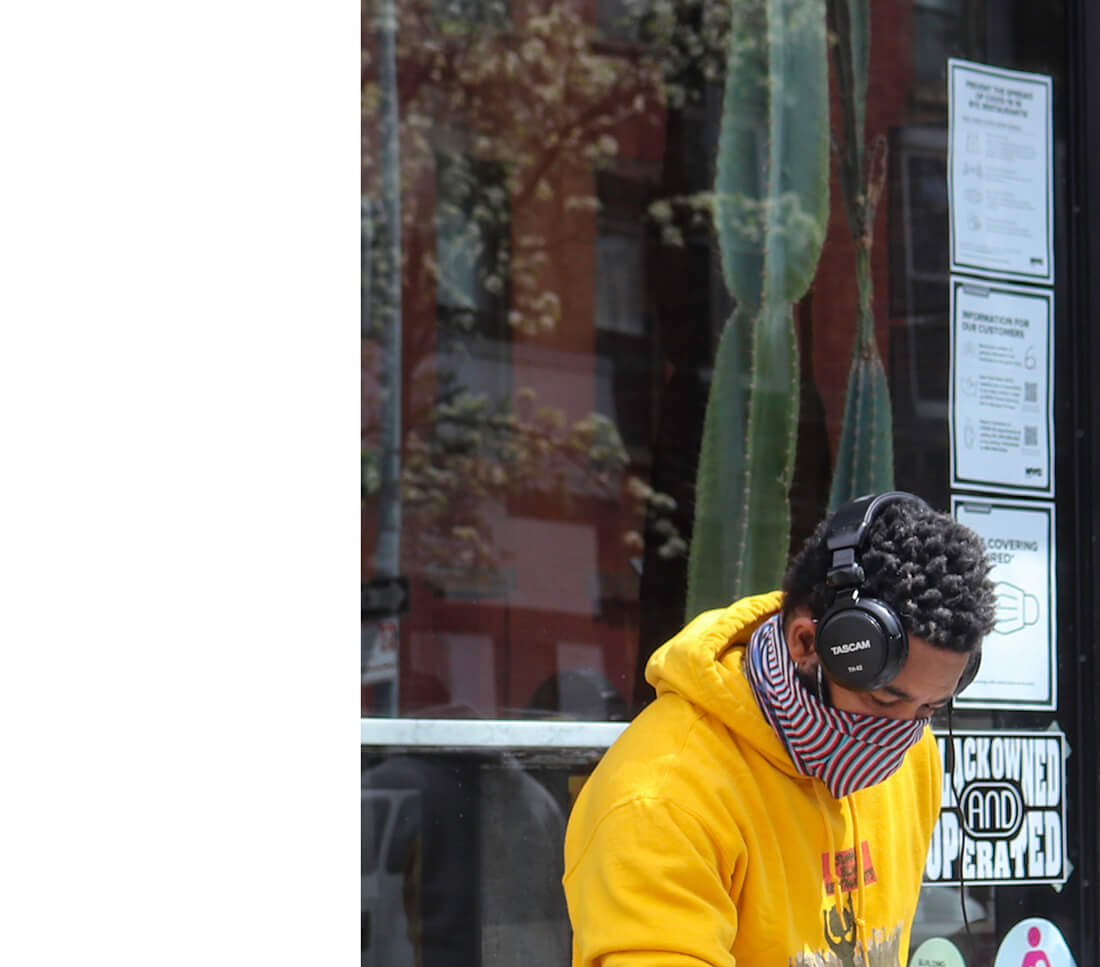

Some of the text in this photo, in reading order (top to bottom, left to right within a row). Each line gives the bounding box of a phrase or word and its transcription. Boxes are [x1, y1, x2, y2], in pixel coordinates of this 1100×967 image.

[988, 537, 1039, 553] COVERING
[830, 639, 871, 656] TASCAM
[967, 790, 1018, 830] AND
[925, 810, 1063, 881] OPERATED
